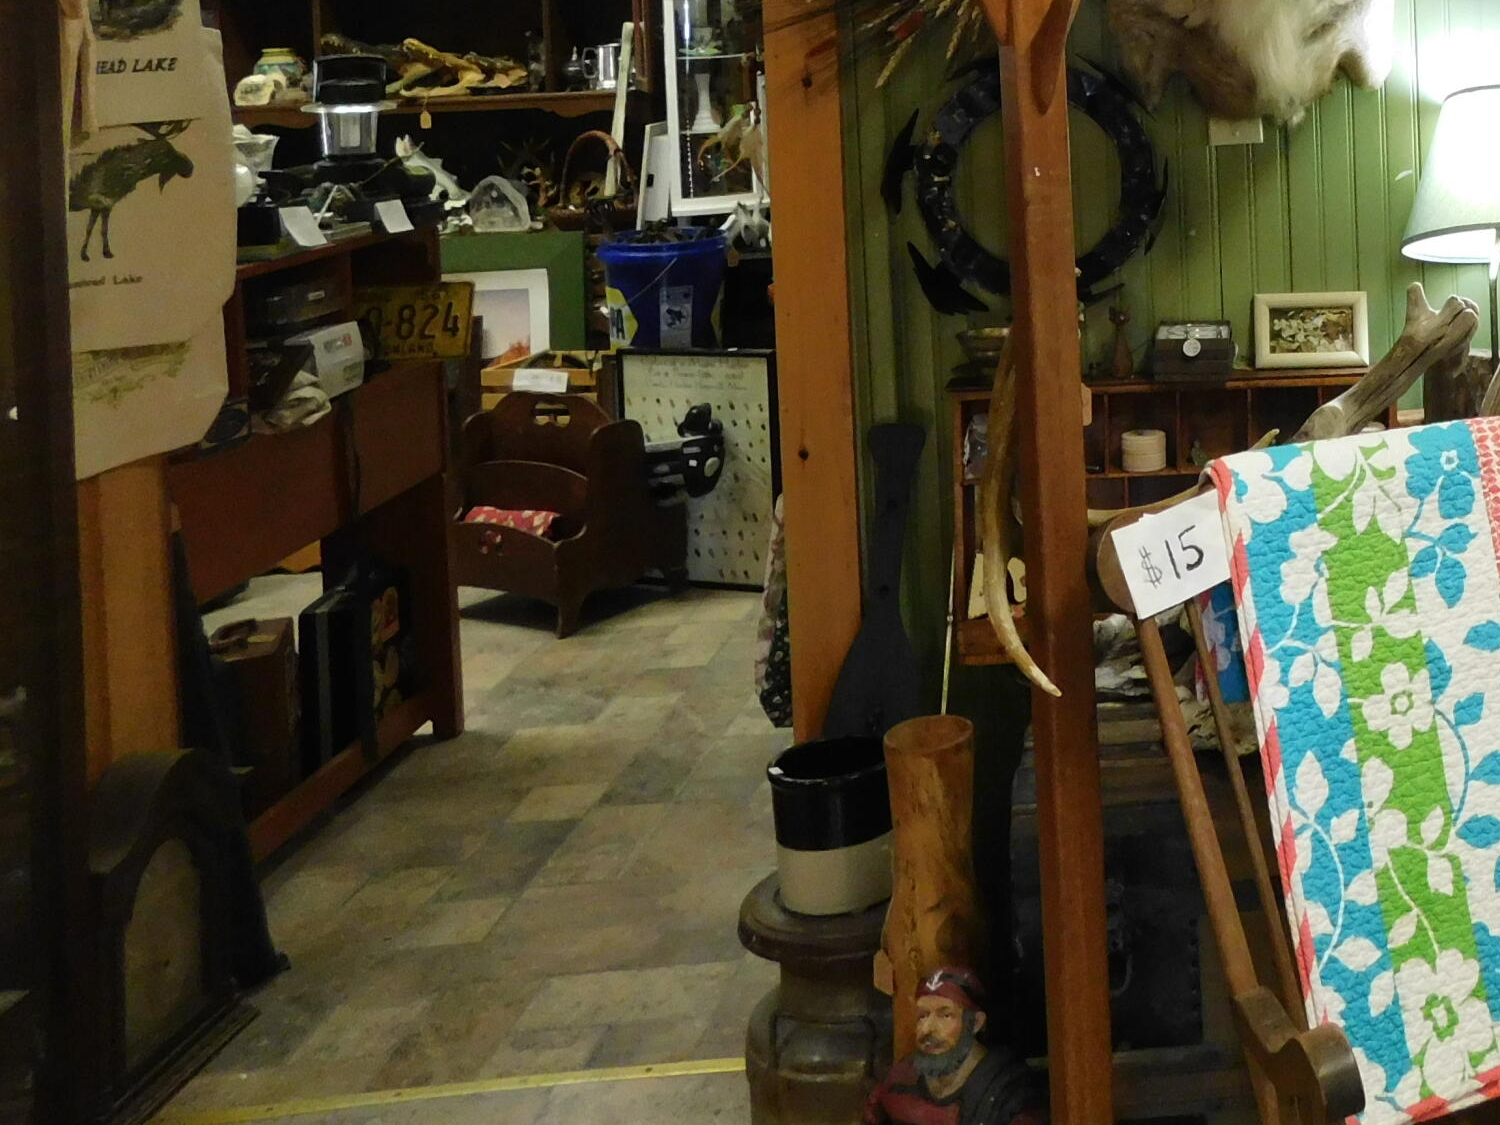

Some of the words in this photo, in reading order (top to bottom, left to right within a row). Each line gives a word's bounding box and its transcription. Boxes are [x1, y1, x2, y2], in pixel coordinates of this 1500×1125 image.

[132, 57, 178, 73] LAKE
[113, 275, 144, 285] Lake
[1138, 524, 1205, 589] $15
